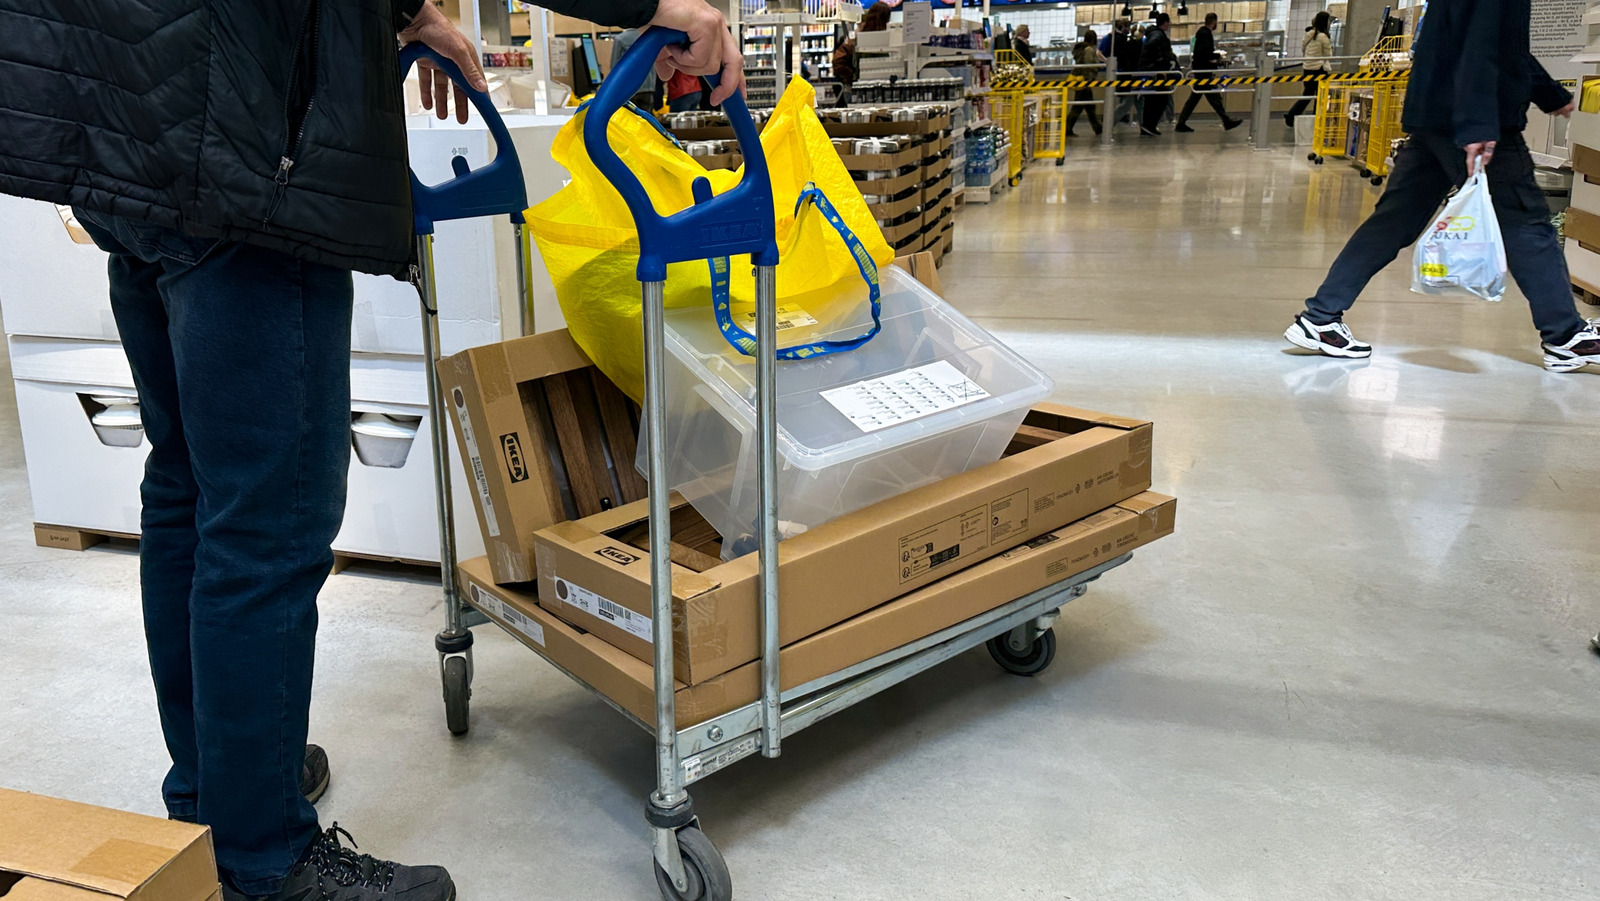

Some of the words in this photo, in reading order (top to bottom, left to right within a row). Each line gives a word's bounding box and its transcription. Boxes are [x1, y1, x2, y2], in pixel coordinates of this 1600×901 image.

[700, 222, 759, 242] IKEA
[506, 438, 522, 477] IKEA
[602, 550, 632, 562] IKEA
